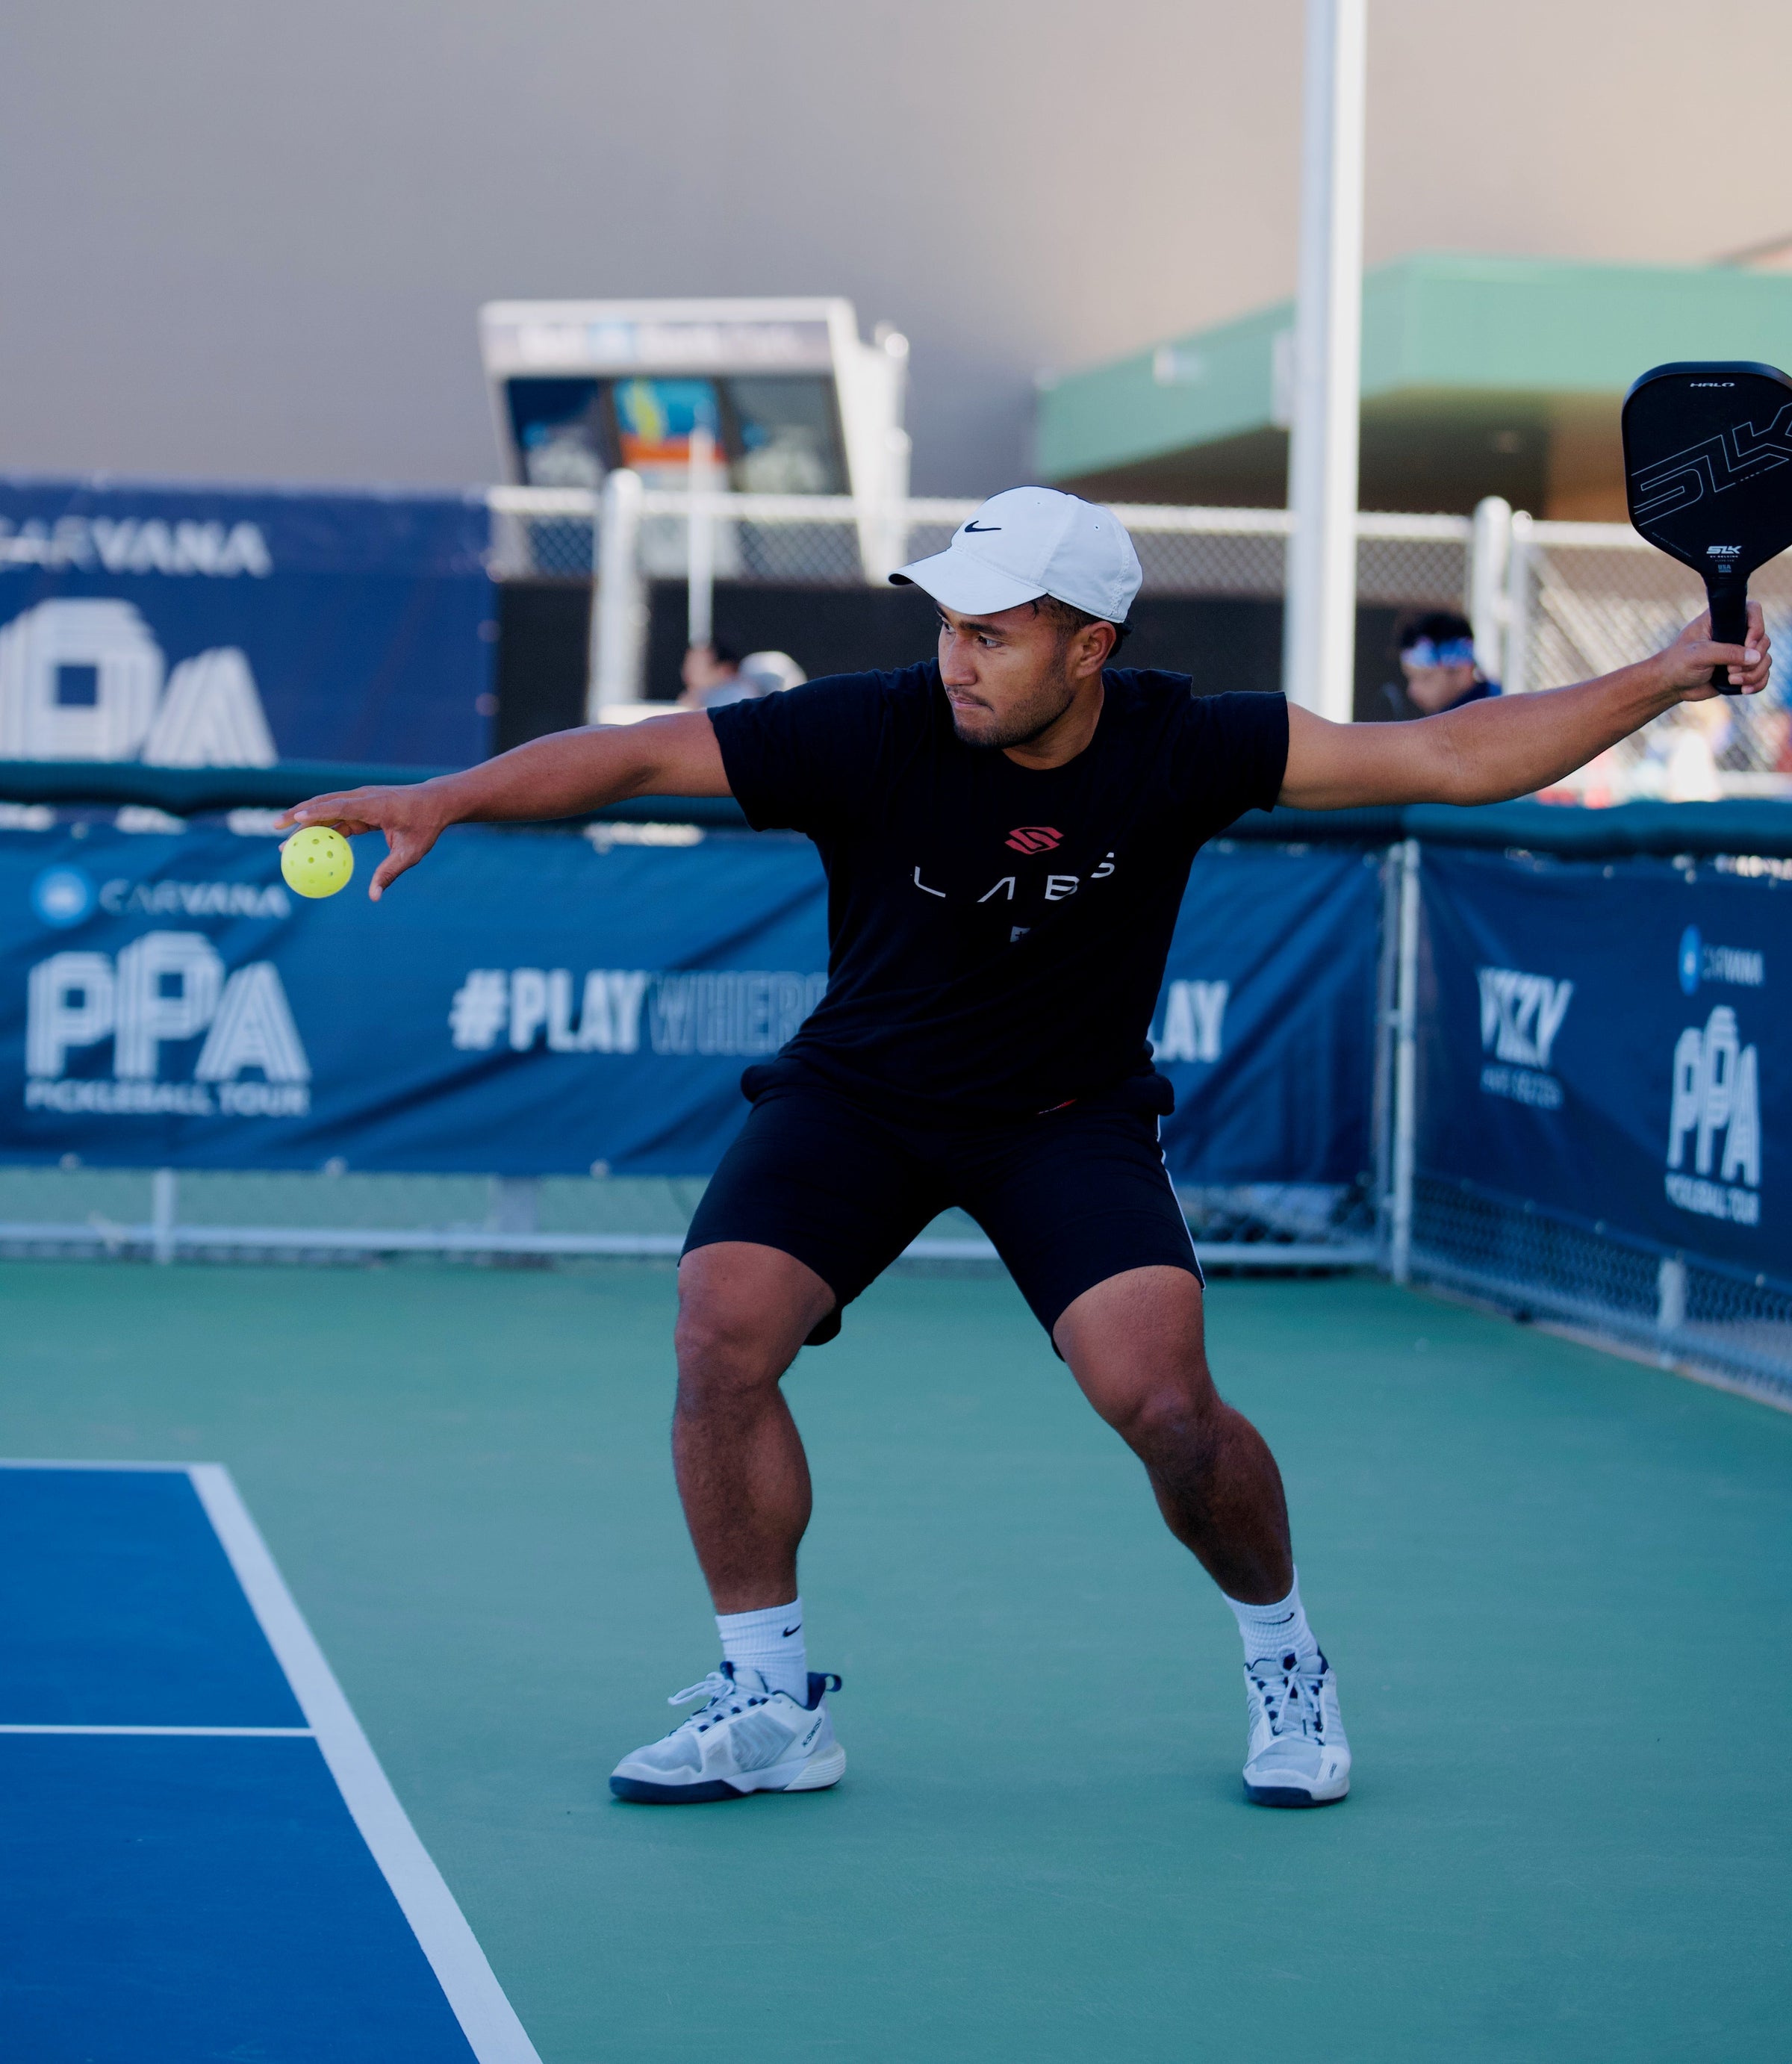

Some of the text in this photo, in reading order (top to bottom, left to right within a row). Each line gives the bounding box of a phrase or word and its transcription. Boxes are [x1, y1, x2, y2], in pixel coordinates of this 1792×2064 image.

[1706, 545, 1742, 555] SLK
[914, 852, 1115, 903] LABS
[27, 930, 311, 1082] PPA
[1667, 1004, 1761, 1187] PPA
